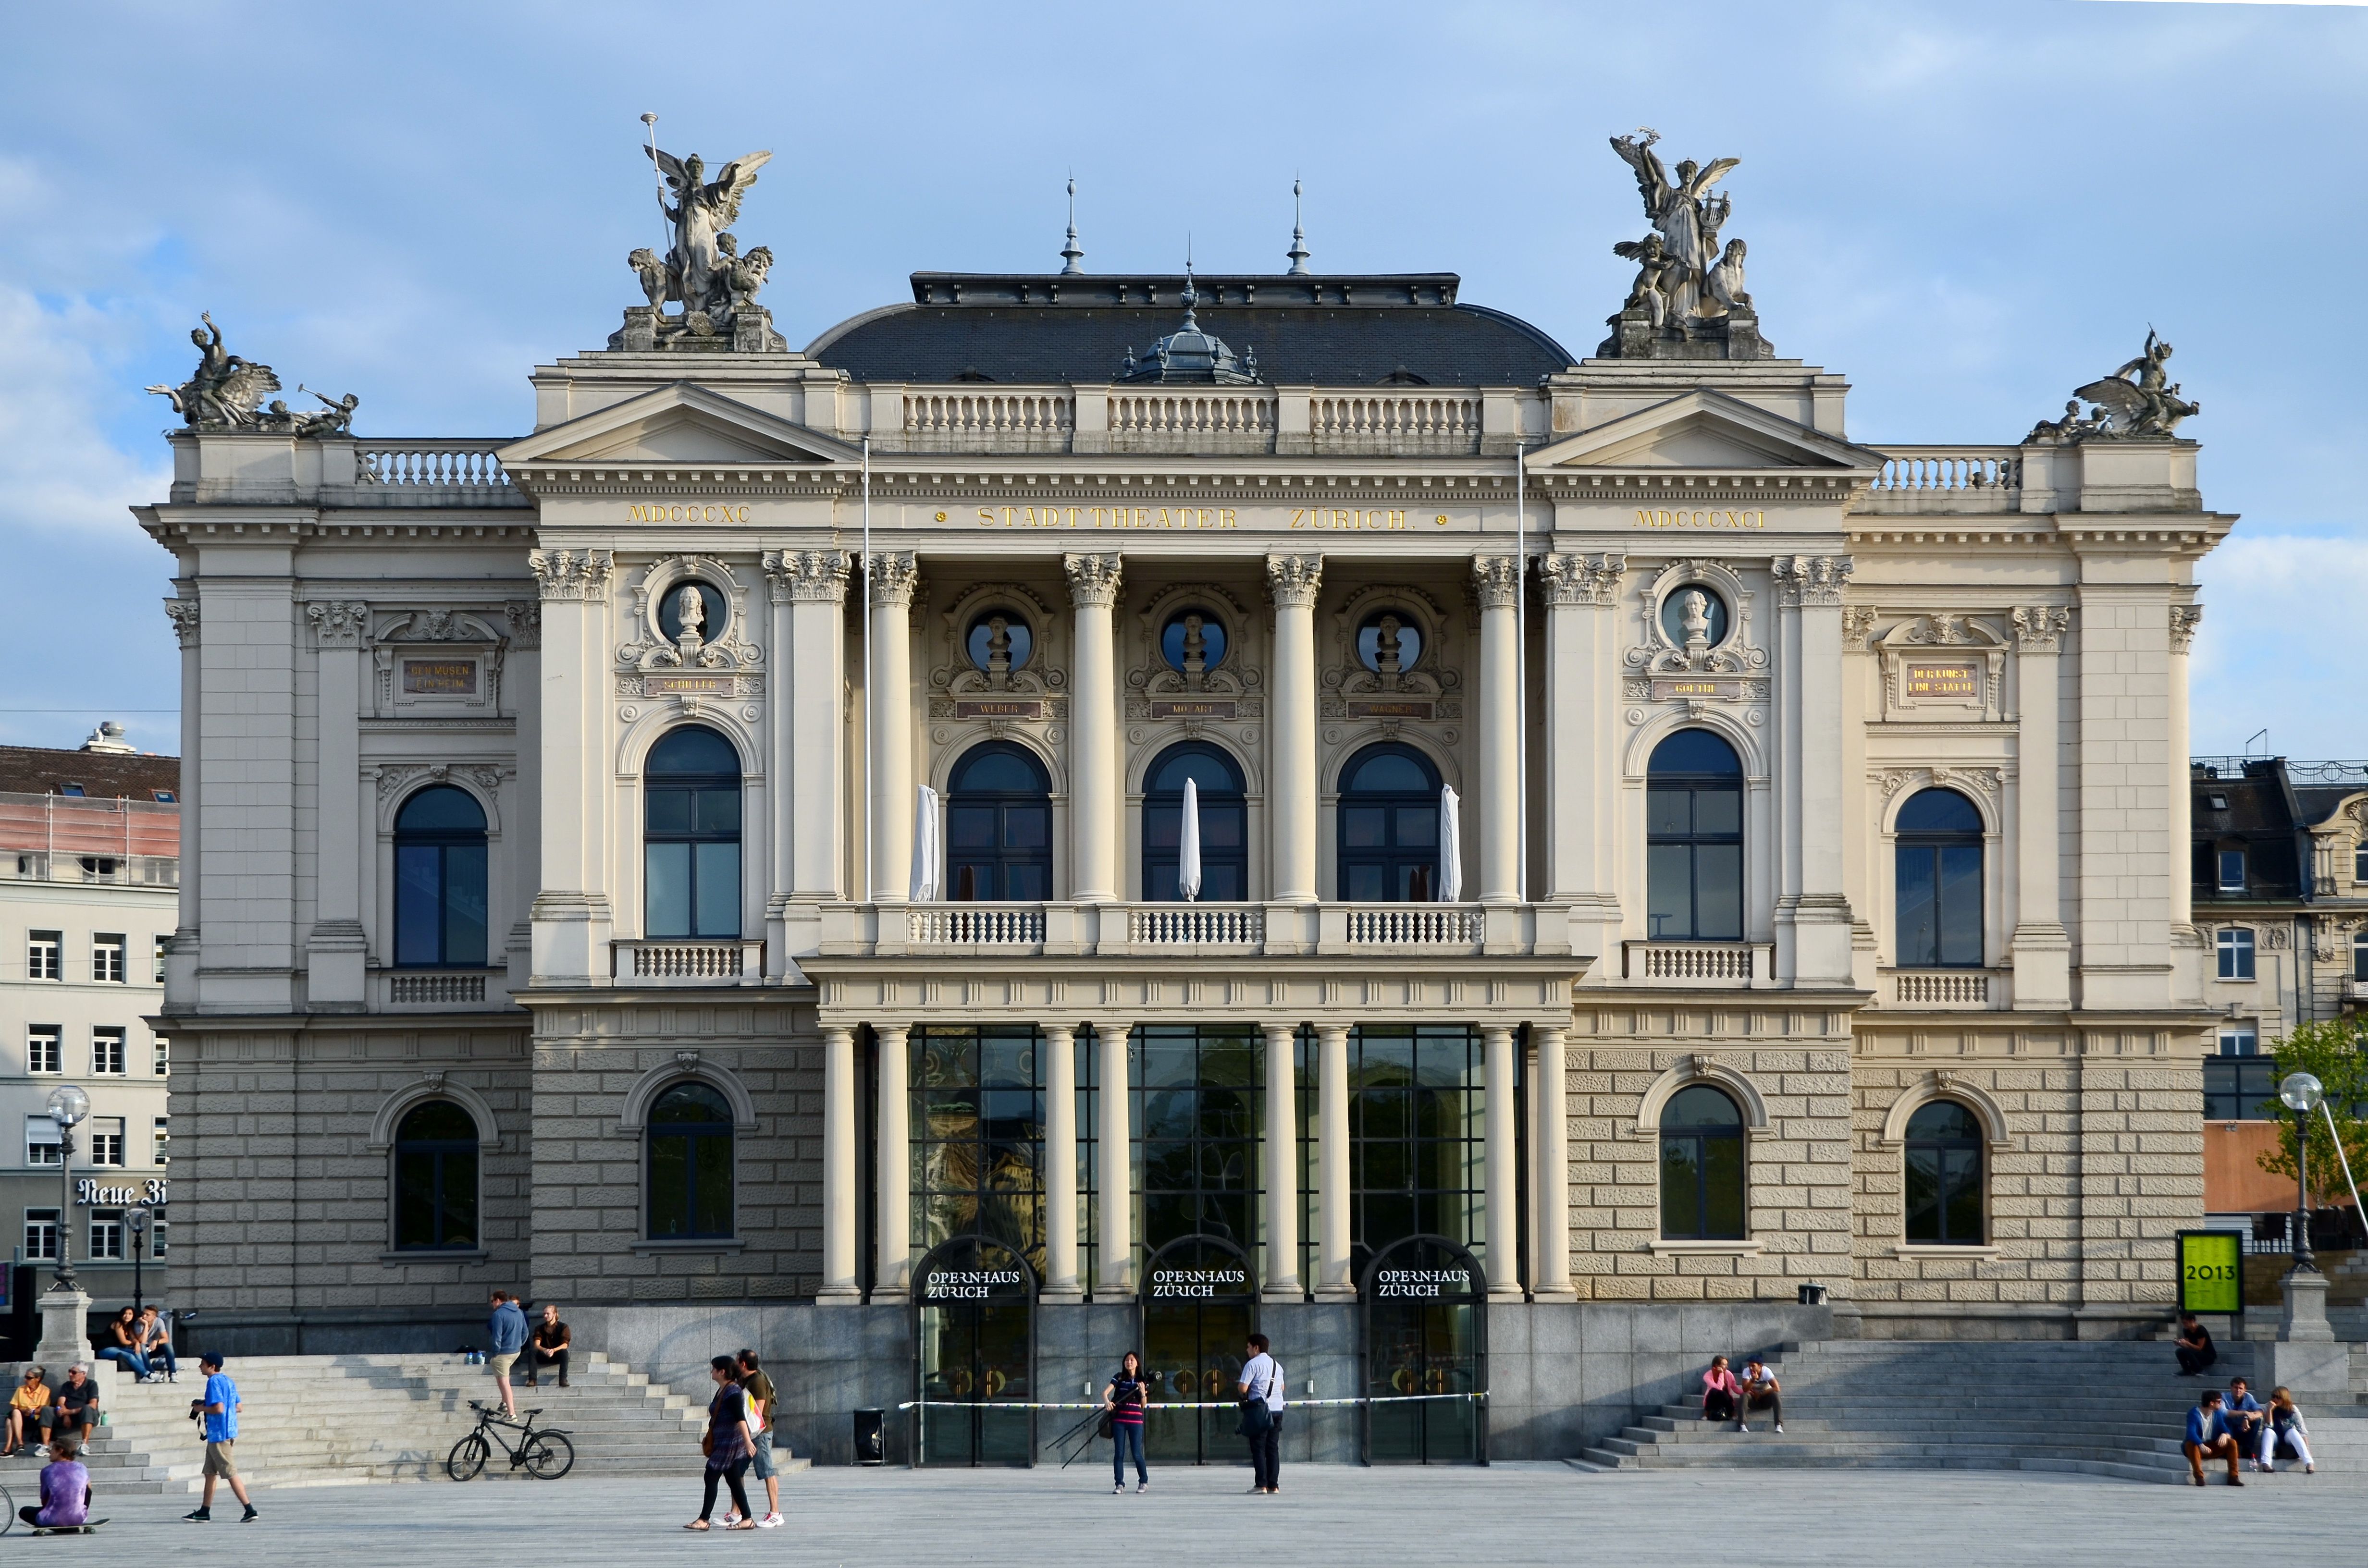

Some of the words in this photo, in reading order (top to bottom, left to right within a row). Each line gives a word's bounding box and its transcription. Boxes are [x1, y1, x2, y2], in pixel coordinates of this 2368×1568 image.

[626, 506, 750, 522] MDCCCXC
[1633, 511, 1764, 527] MDCCCXCI
[411, 666, 431, 674] DEN
[435, 666, 469, 675] MUSEN
[1914, 670, 1934, 678] DER
[1936, 670, 1968, 678] KUNST
[417, 679, 434, 688] EIN
[438, 680, 465, 688] HEIM
[981, 705, 1018, 713] WEBER
[1173, 705, 1212, 713] MOART
[1370, 705, 1412, 713] WAGNER
[77, 1178, 140, 1204] Neue
[928, 1271, 1020, 1284] OPERNHAUS
[1153, 1270, 1245, 1282] OPERNHAUS
[1379, 1270, 1470, 1282] OPERNHAUS
[2186, 1265, 2235, 1280] 2013
[928, 1284, 989, 1298] ZÜRICH
[1153, 1283, 1214, 1297] ZÜRICH
[1379, 1282, 1440, 1296] ZÜRICH
